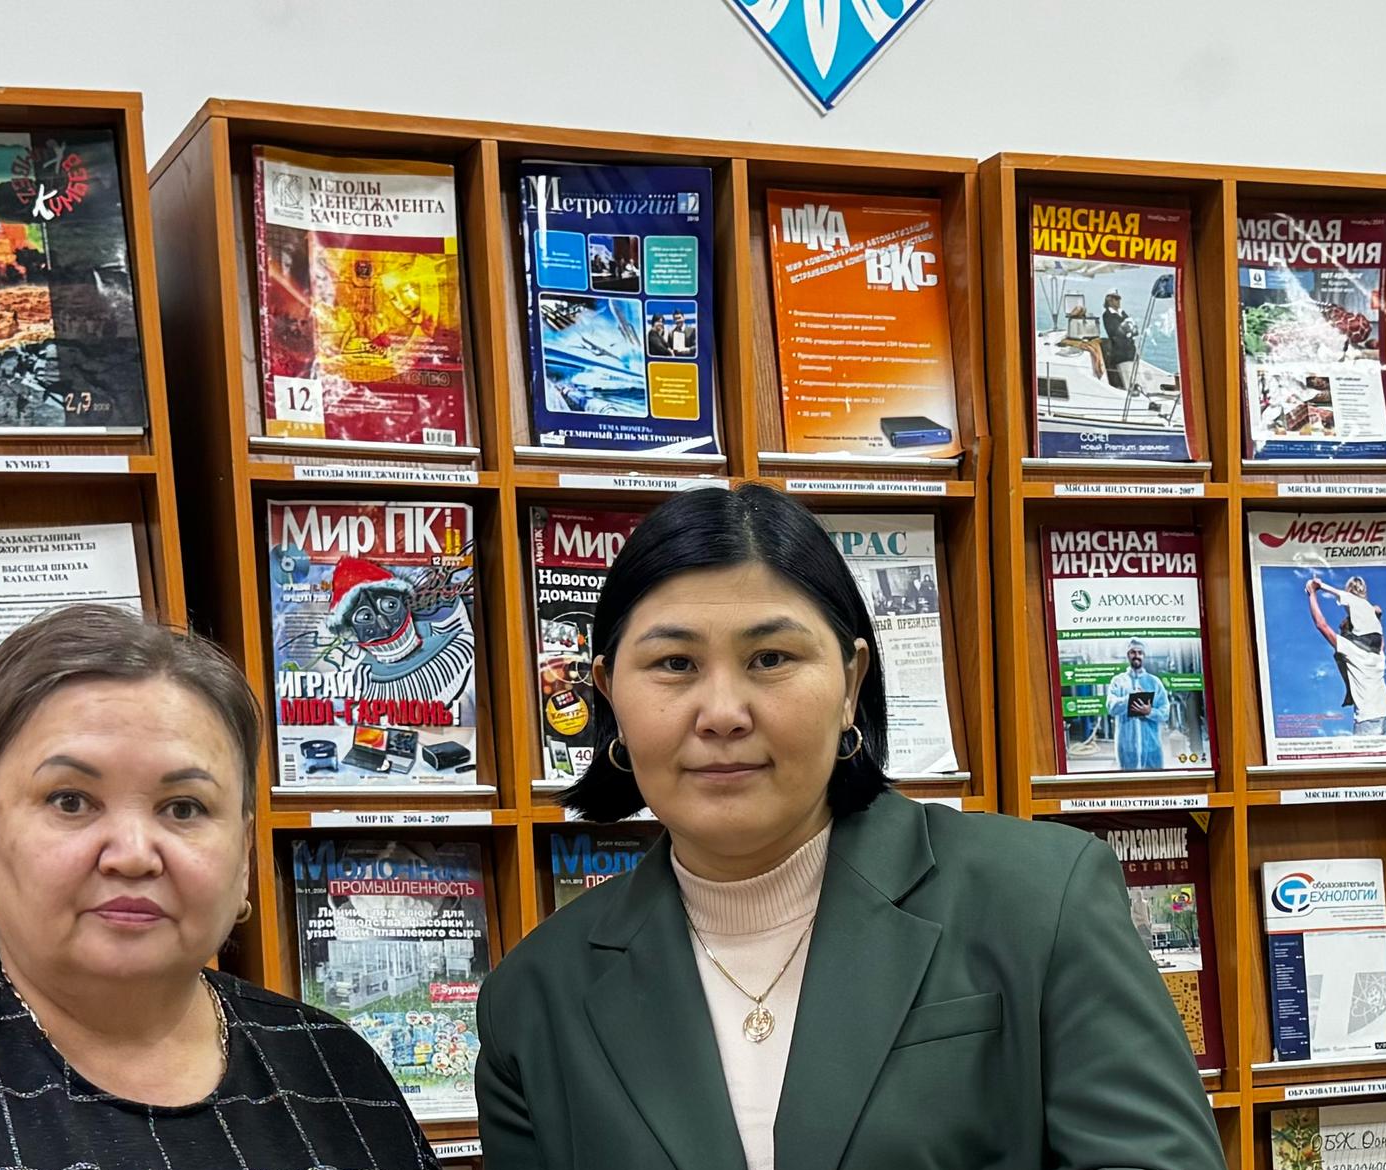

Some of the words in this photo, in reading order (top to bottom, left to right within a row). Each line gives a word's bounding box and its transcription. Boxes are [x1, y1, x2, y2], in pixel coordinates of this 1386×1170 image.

[309, 177, 381, 196] МЕТОДЫ
[310, 194, 445, 214] МЕНЕДЖМЕНТА
[526, 176, 677, 219] Метрология
[310, 209, 393, 228] КАЧЕСТВА
[781, 204, 850, 251] МКА
[1032, 204, 1141, 235] МЯСНАЯ
[1238, 217, 1342, 242] МЯСНАЯ
[1032, 228, 1177, 263] ИНДУСТРИЯ
[1238, 243, 1382, 265] ИНДУСТРИЯ
[865, 246, 938, 291] ВКС
[286, 386, 313, 412] 12
[302, 469, 344, 480] МЕТОДЫ
[422, 471, 472, 483] КАЧЕСТВА
[613, 479, 677, 489] МЕТРОЛОГИЯ
[1064, 484, 1098, 494] МЯСНАЯ
[1102, 485, 1155, 494] ИНДУСТРИЯ
[282, 506, 376, 556] Мир
[386, 506, 442, 554] ПК
[1051, 531, 1157, 552] МЯСНАЯ
[553, 521, 625, 566] Мир
[1052, 553, 1197, 577] ИНДУСТРИЯ
[2, 574, 69, 583] КАЗАХСТАНА
[1098, 593, 1184, 608] АРОМАРОС-М
[278, 670, 355, 698] ИГРАЙ
[1070, 799, 1106, 808] МЯСНАЯ
[1305, 791, 1341, 800] МЯСНЫЕ
[355, 815, 376, 823] МИР
[403, 815, 421, 823] 2004
[431, 815, 449, 823] 2007
[330, 881, 474, 895] ПРОМЫШЛЕННОСТЬ
